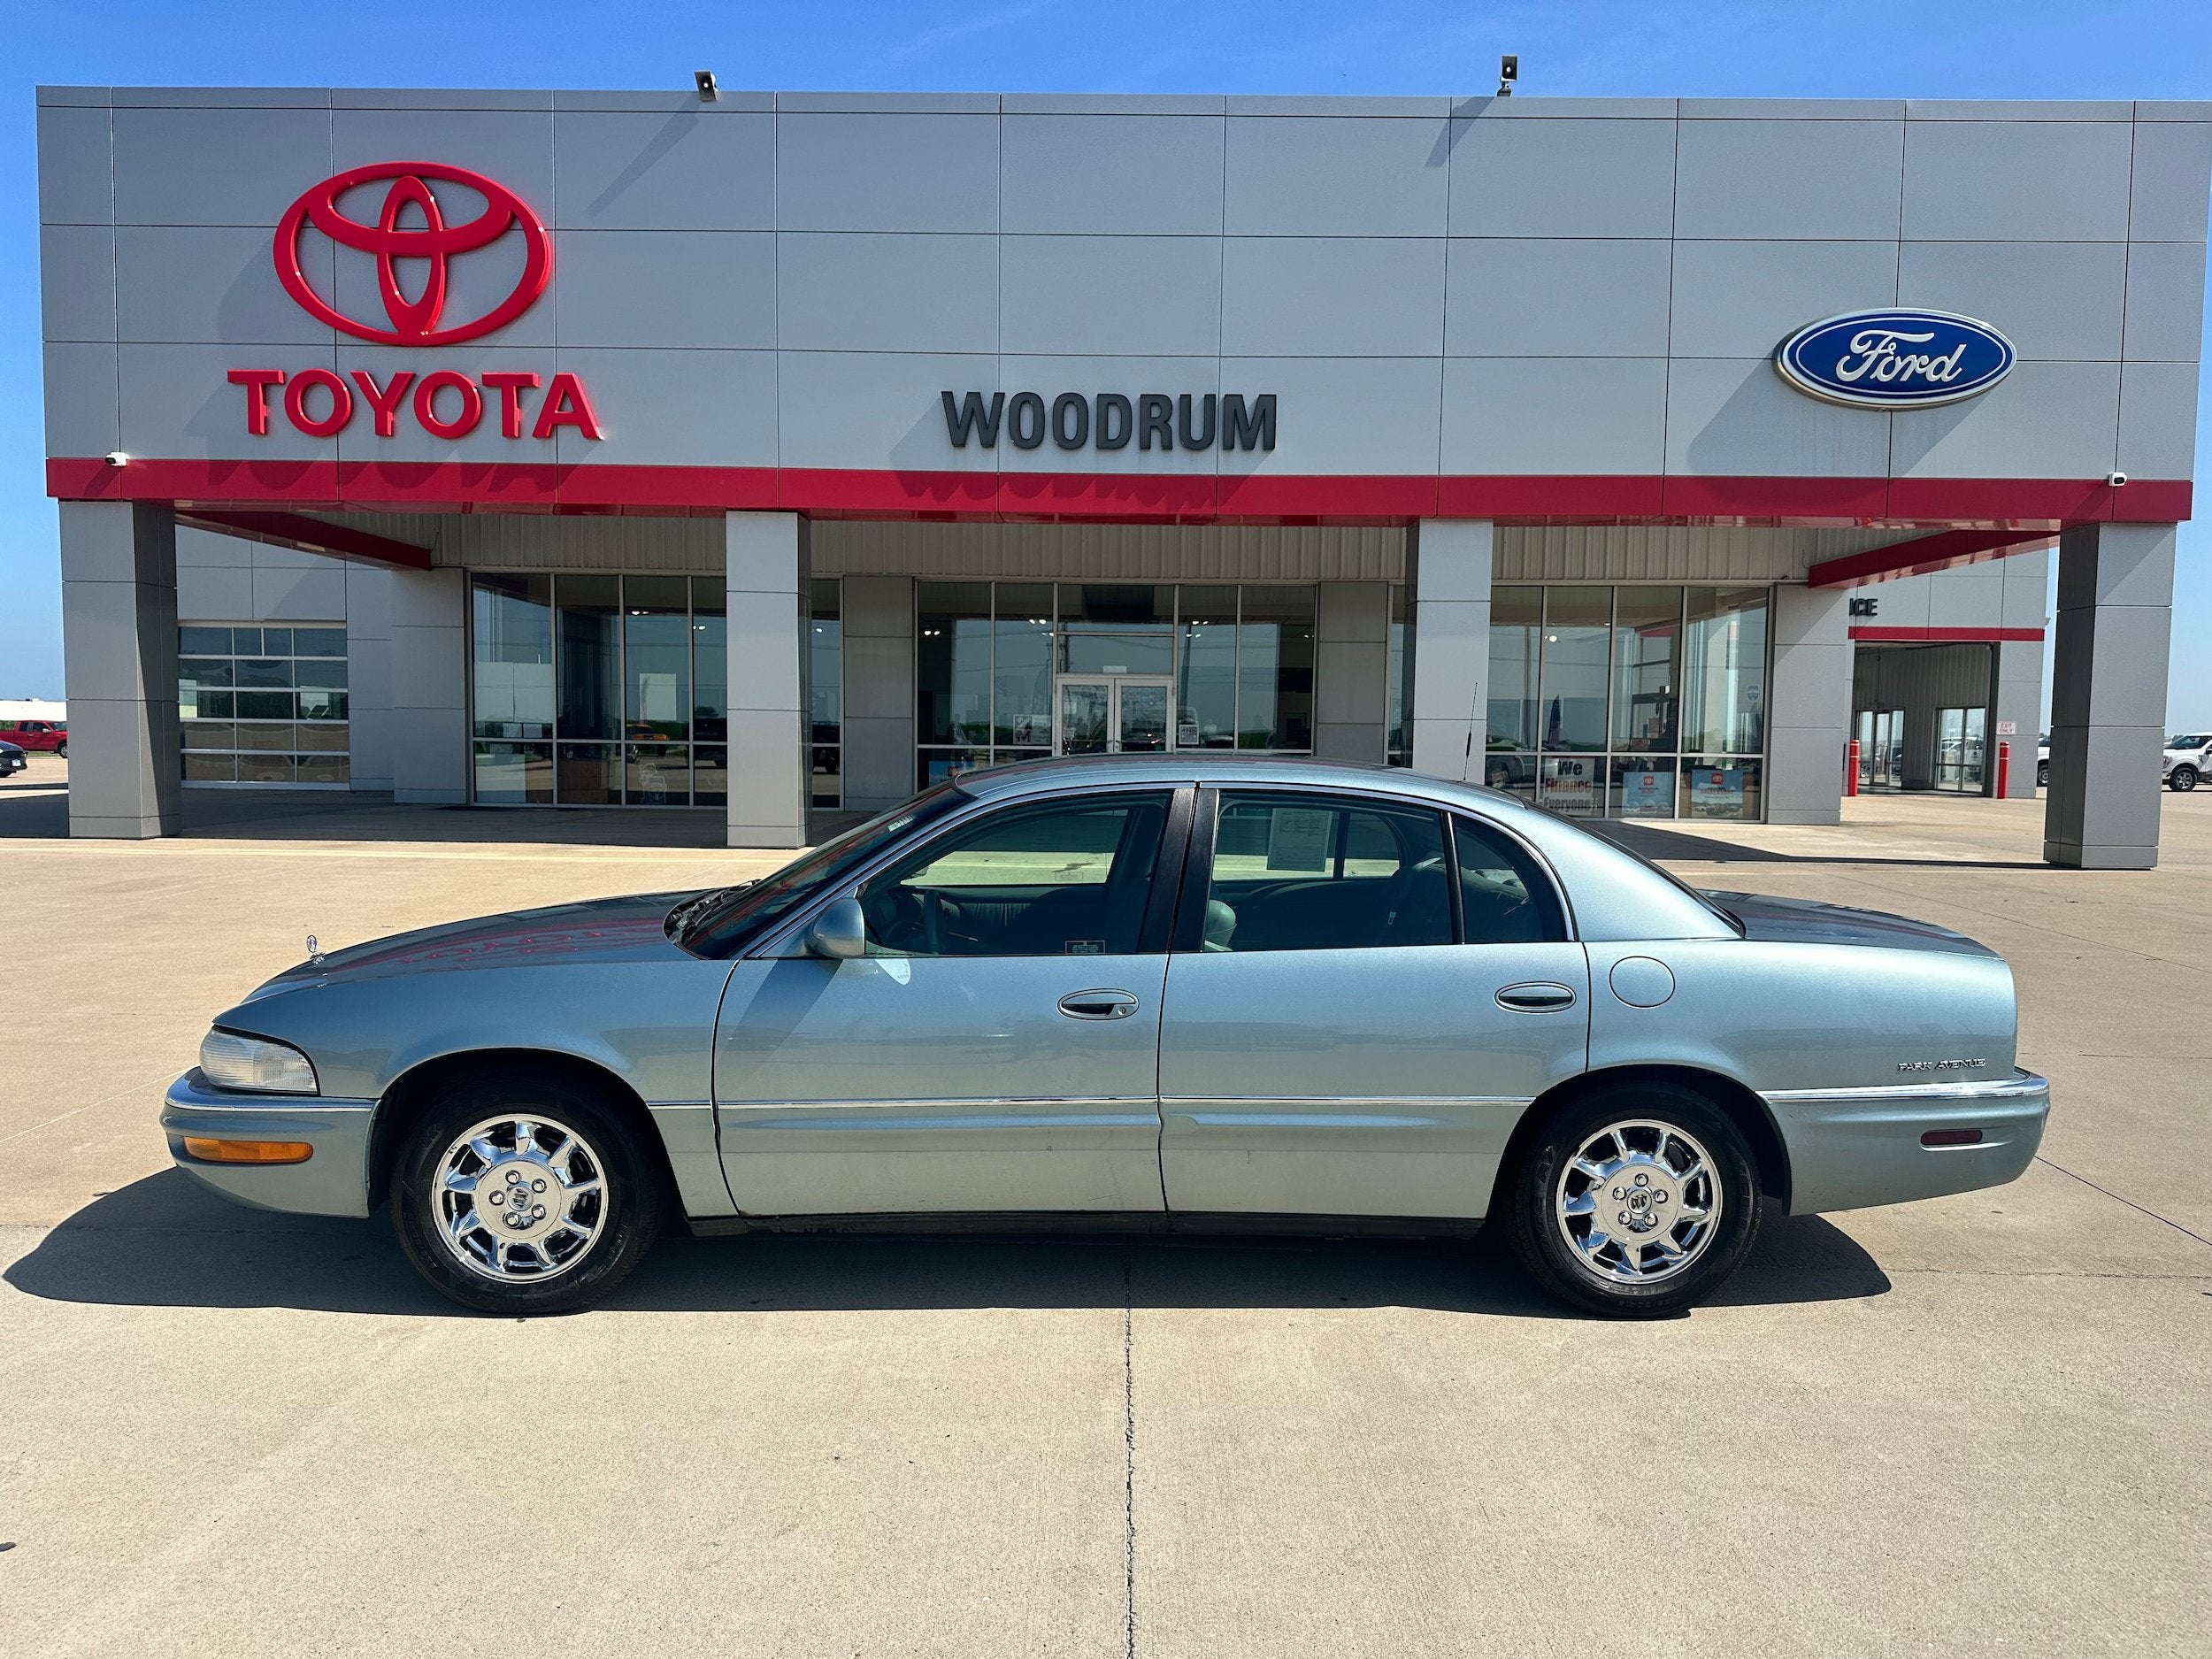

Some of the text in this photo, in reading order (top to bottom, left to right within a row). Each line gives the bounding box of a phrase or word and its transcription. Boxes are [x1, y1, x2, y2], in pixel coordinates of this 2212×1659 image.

[1836, 329, 1967, 382] Ford
[227, 368, 603, 440] TOYOTA
[941, 391, 1277, 450] WOODRUM
[1557, 761, 1583, 775] We
[1545, 779, 1592, 793] Finance
[1897, 1058, 1986, 1071] PARK AVENUE
